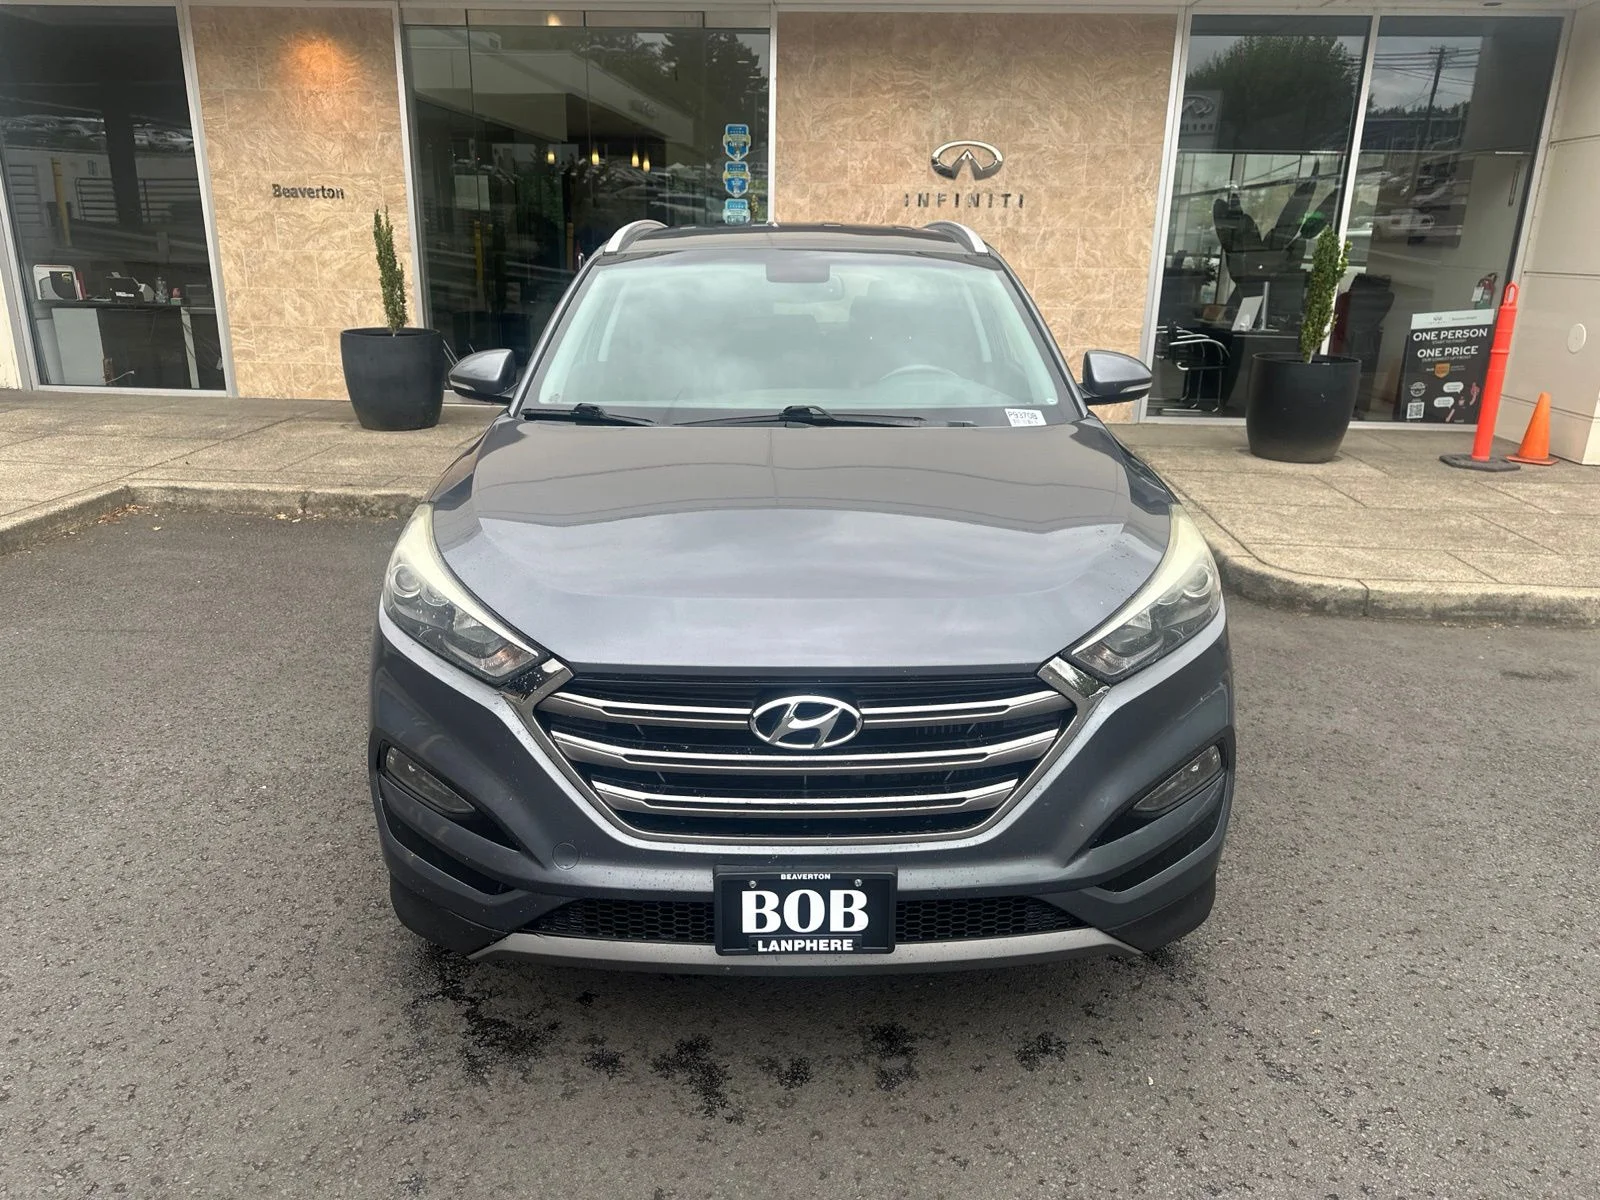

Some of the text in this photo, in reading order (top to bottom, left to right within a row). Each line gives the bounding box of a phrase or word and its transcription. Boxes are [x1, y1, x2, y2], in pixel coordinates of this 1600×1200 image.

[272, 183, 344, 199] Beaverton
[904, 192, 1024, 208] INFINITI
[1412, 328, 1488, 341] ONE PERSON
[1417, 345, 1479, 358] ONE PRICE
[742, 889, 869, 933] BOB
[757, 939, 854, 952] LANPHERE
